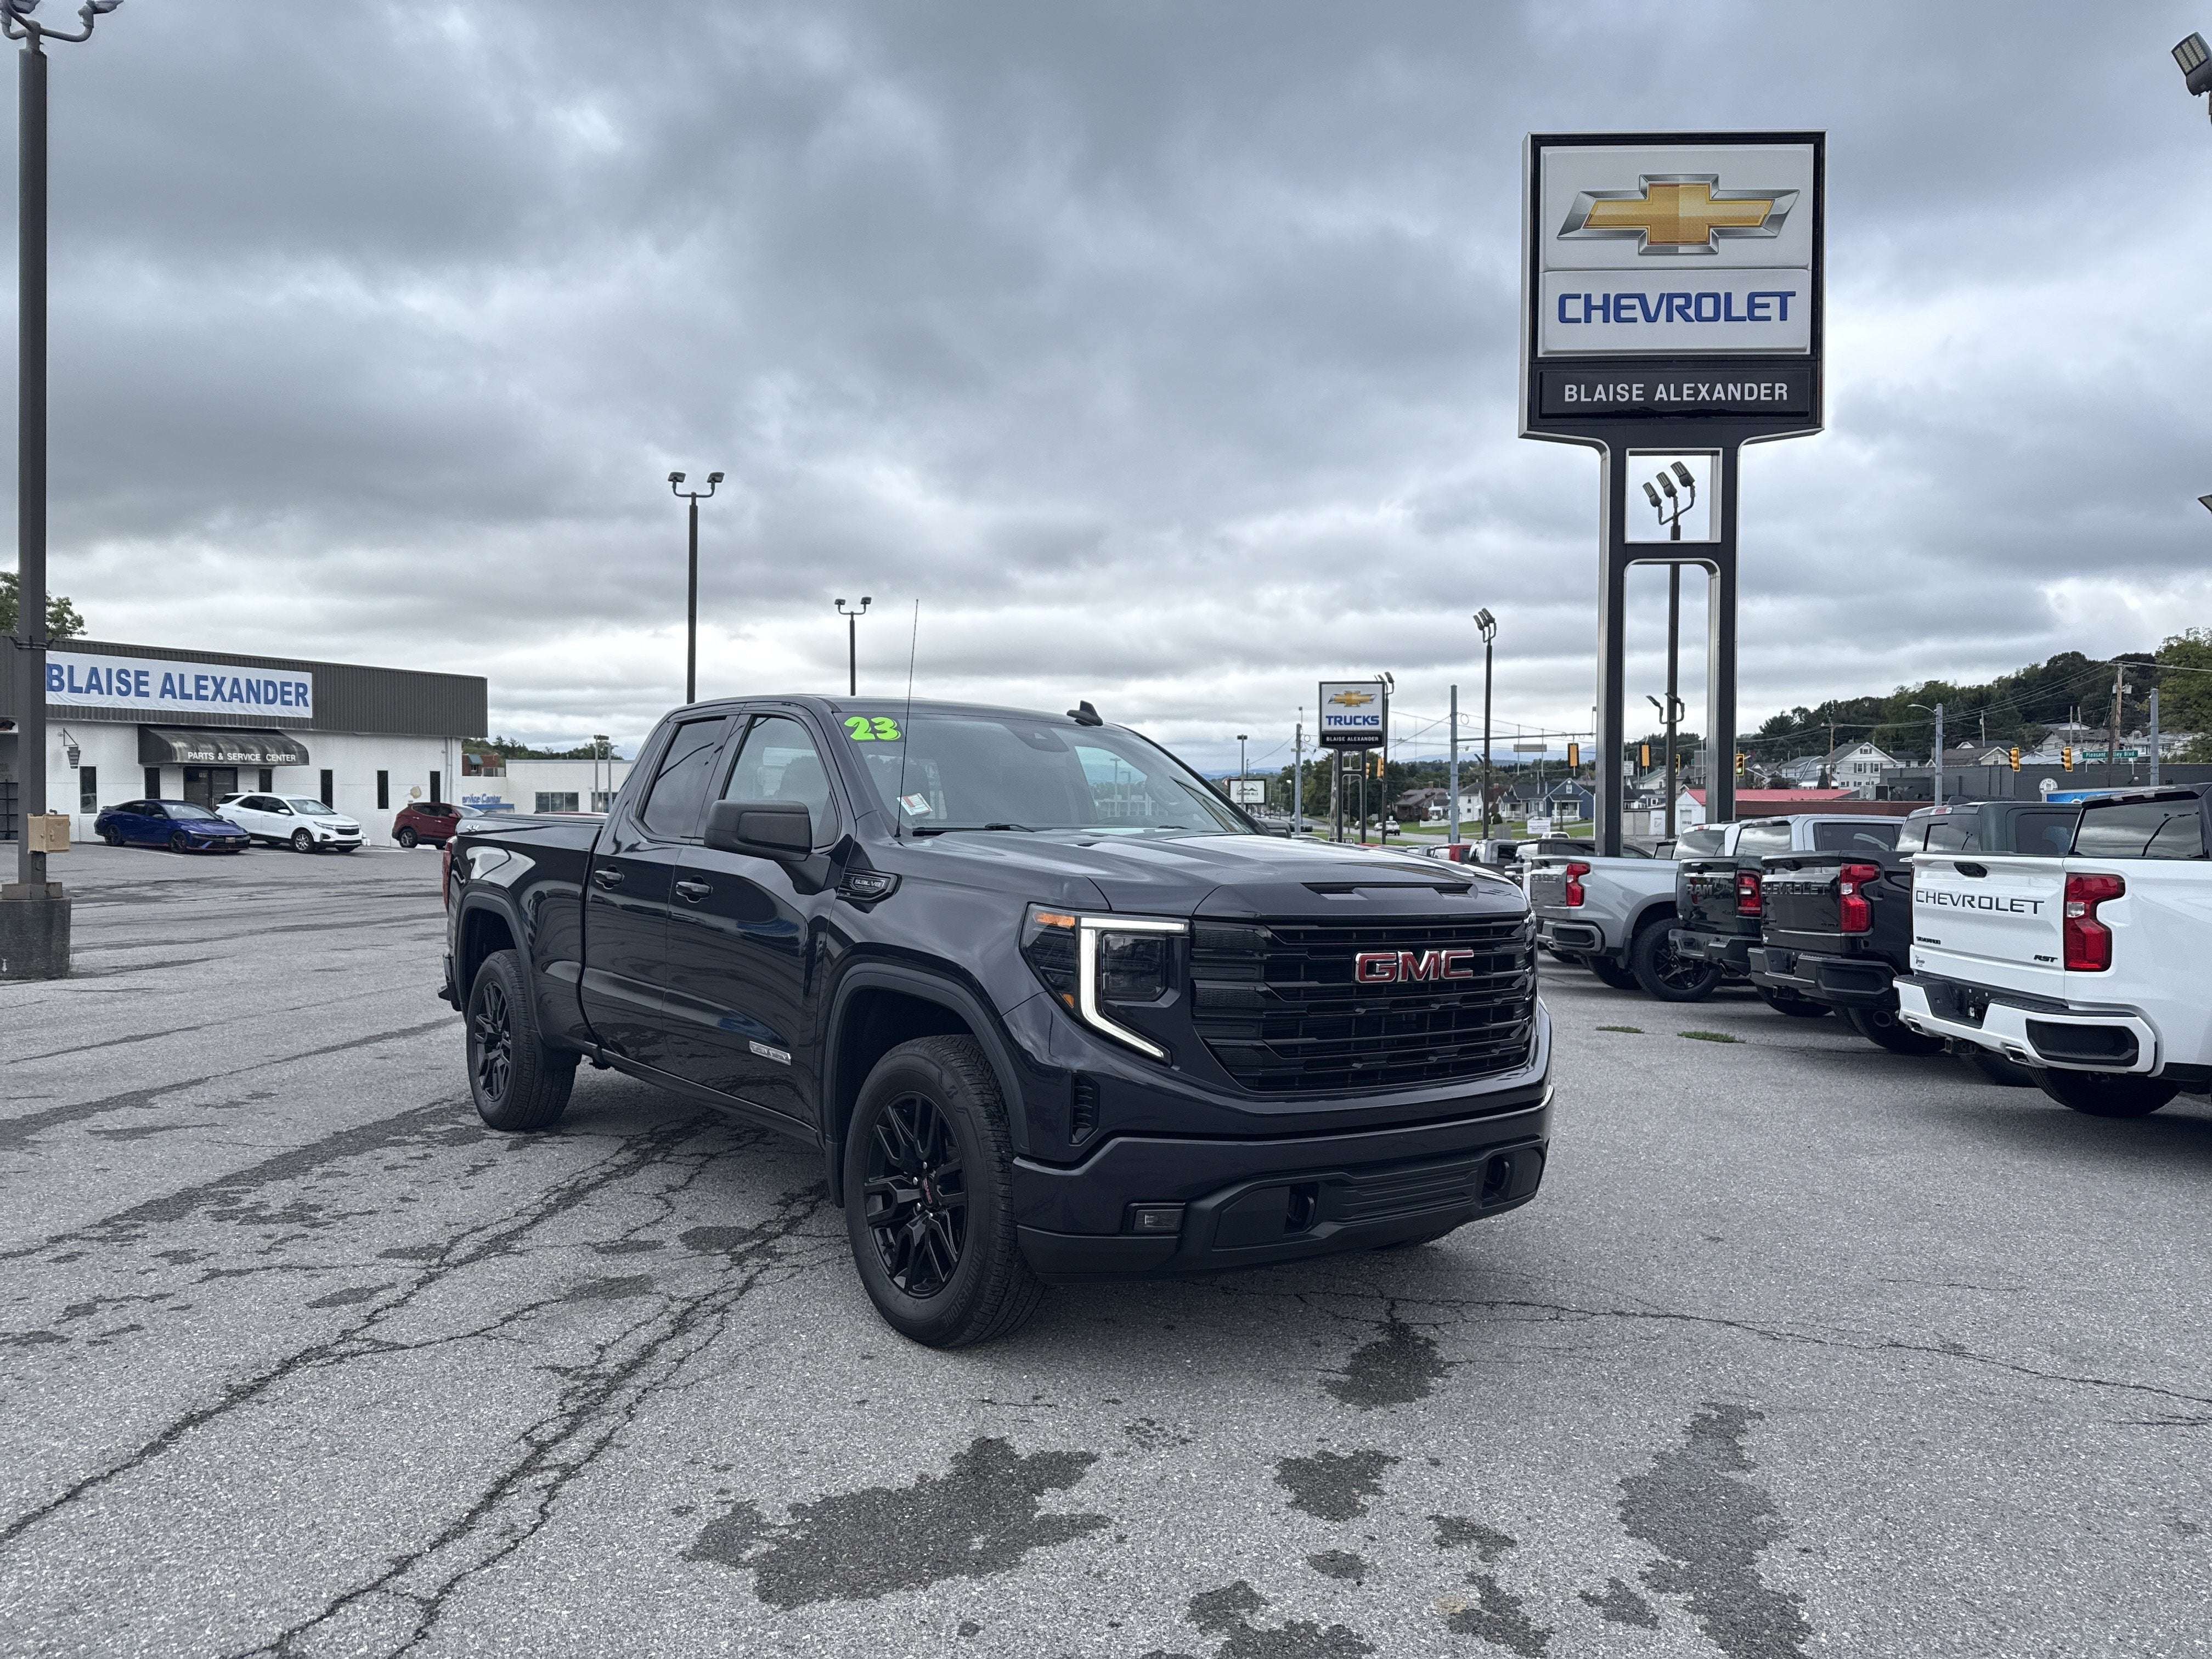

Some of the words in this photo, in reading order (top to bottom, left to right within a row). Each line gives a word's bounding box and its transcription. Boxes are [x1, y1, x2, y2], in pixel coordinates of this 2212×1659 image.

[1559, 291, 1796, 323] CHEVROLET
[1565, 383, 1644, 402] BLAISE
[1654, 383, 1787, 401] ALEXANDER
[46, 663, 150, 698] BLAISE
[159, 672, 309, 707] ALEXANDER
[844, 716, 901, 740] 23
[1325, 715, 1379, 725] TRUCKS
[188, 752, 215, 760] PARTS
[227, 753, 261, 761] SERVICE
[462, 794, 481, 804] ervice
[482, 793, 501, 803] Center
[1686, 884, 1713, 895] RAM
[1916, 890, 2044, 915] CHEVROLET
[1355, 950, 1474, 983] GMC
